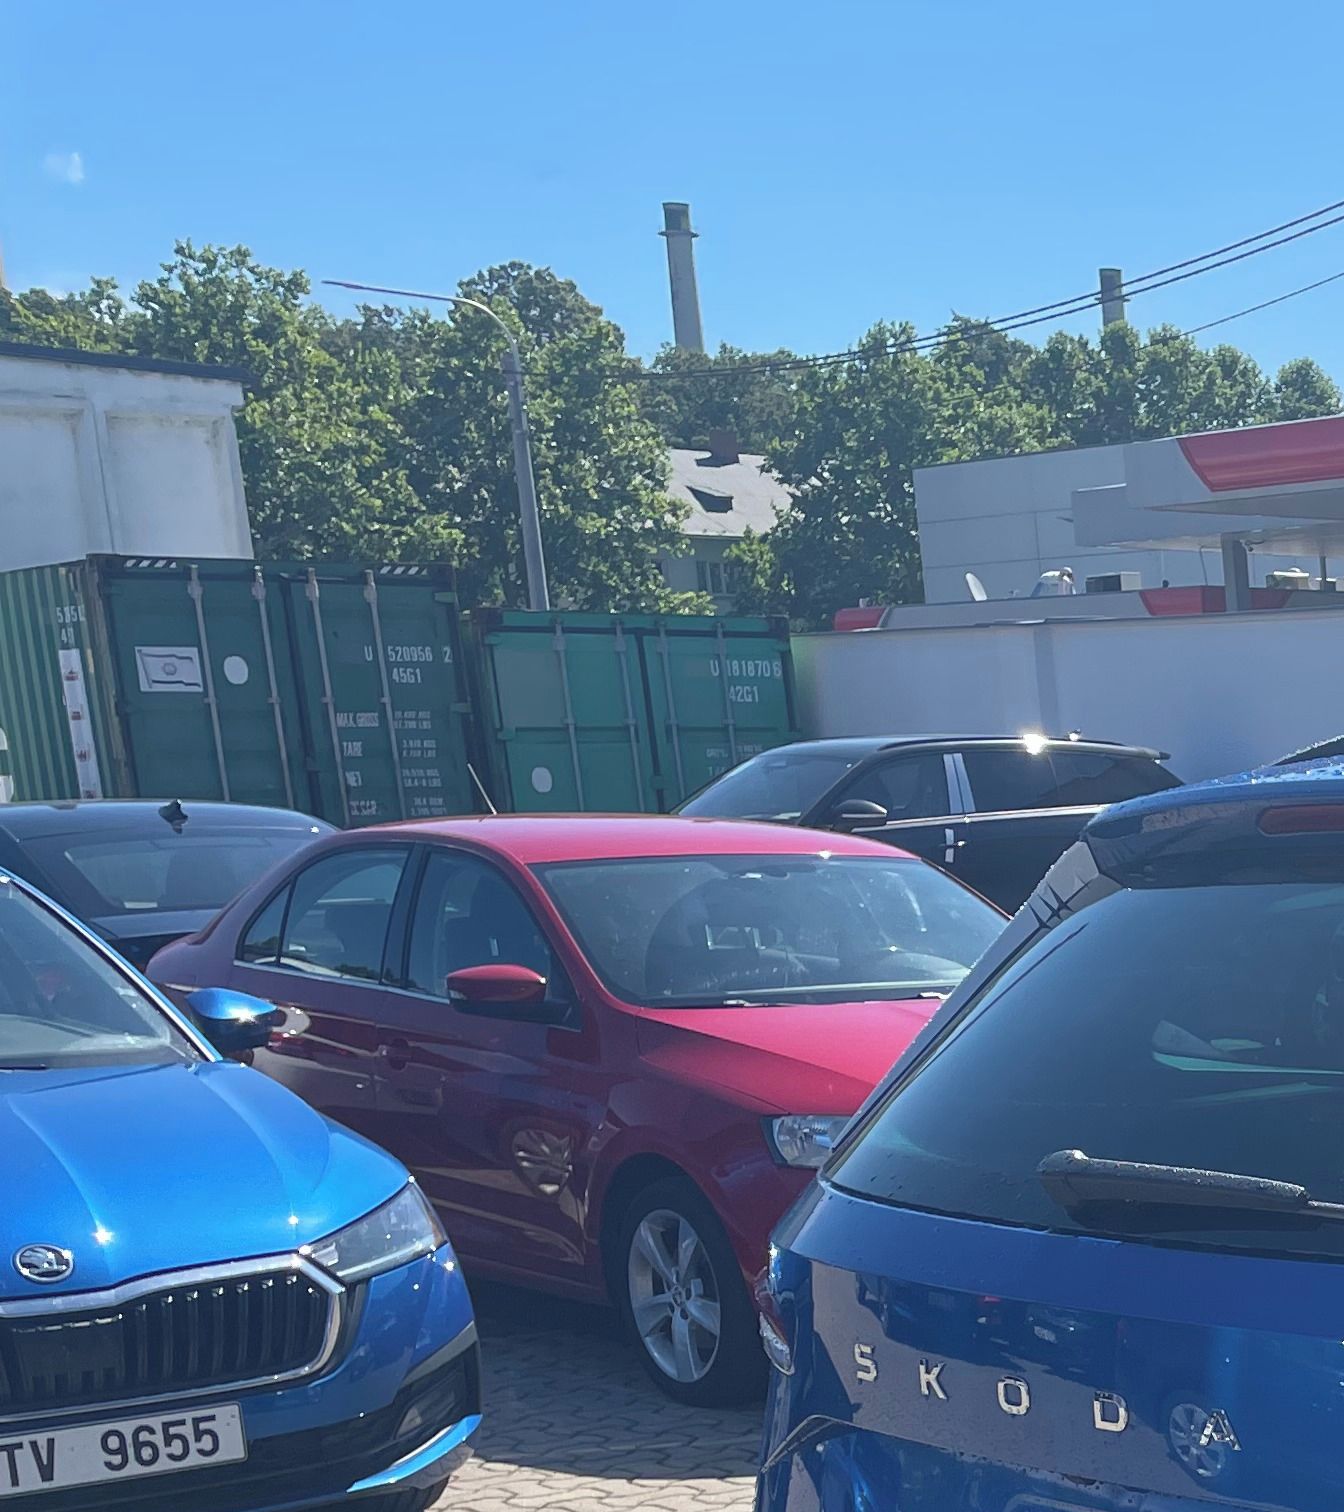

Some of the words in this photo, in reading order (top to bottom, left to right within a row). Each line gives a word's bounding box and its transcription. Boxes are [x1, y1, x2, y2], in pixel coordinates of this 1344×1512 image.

[387, 645, 433, 662] 520956
[392, 667, 422, 683] 45G1
[728, 685, 759, 703] 42G1
[0, 1438, 56, 1488] TV
[100, 1414, 220, 1472] 9655
